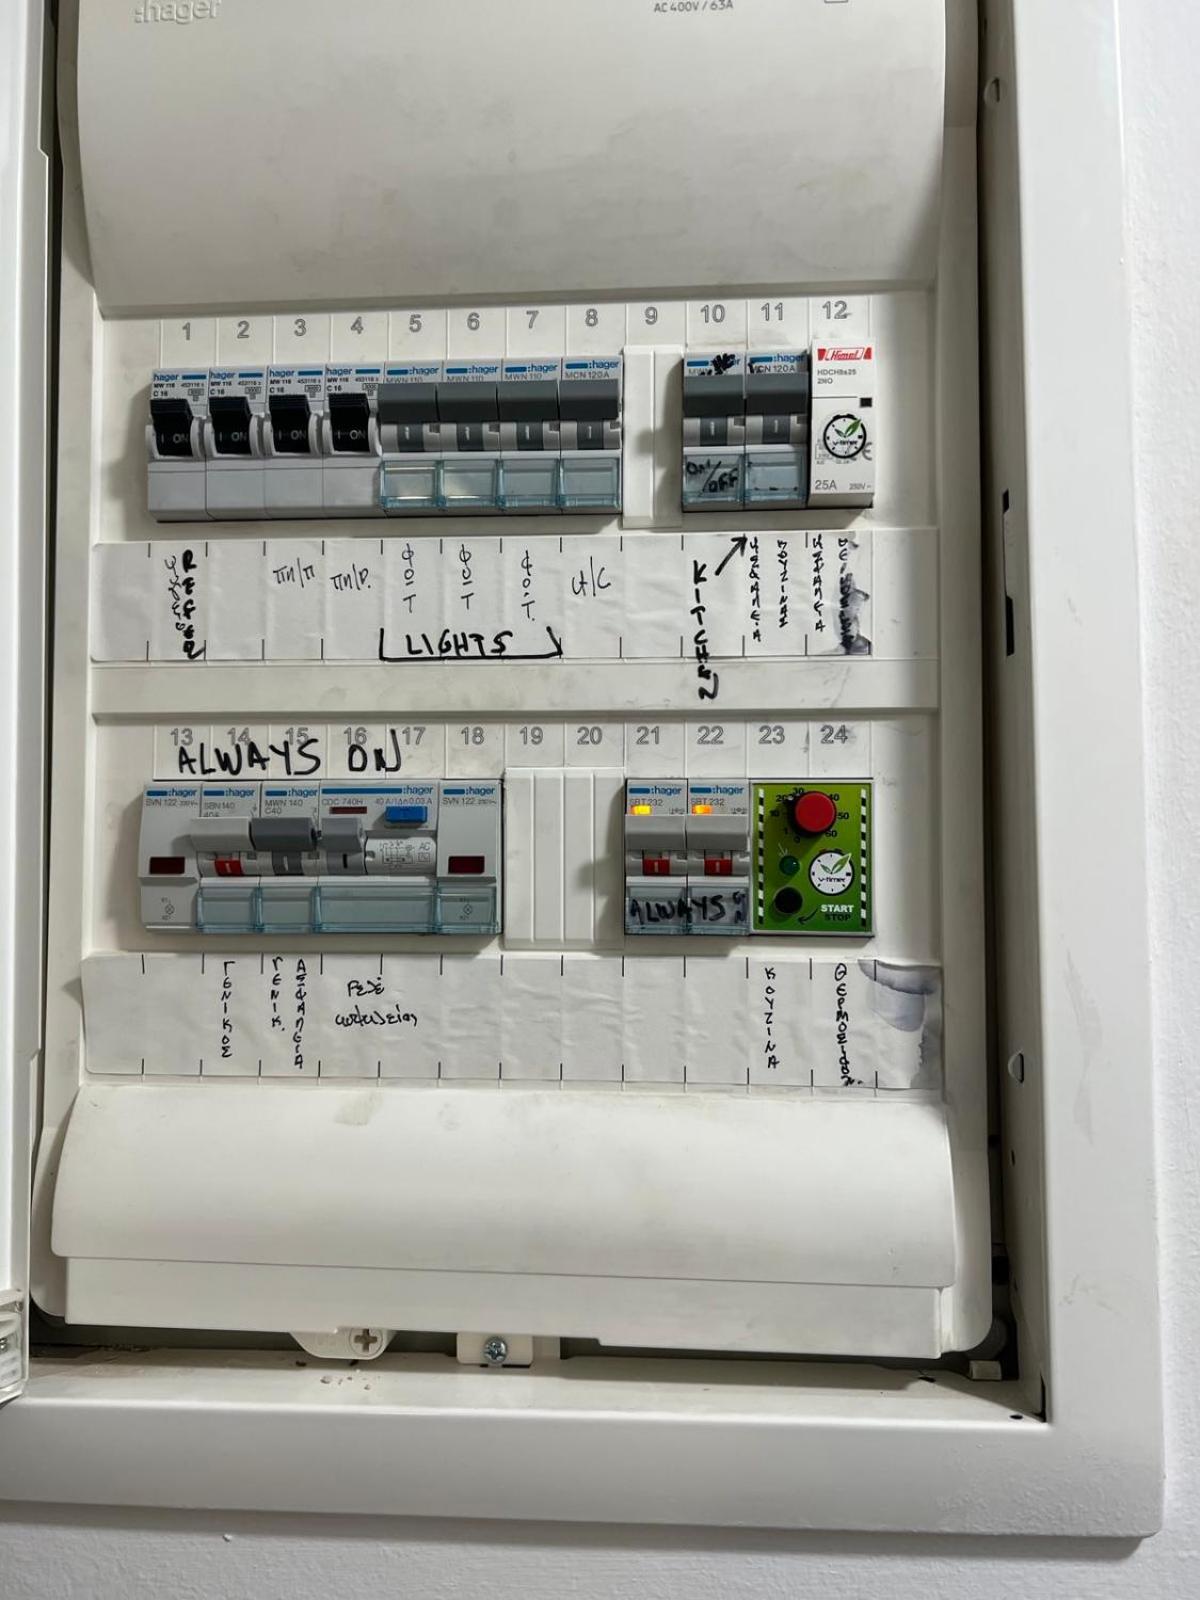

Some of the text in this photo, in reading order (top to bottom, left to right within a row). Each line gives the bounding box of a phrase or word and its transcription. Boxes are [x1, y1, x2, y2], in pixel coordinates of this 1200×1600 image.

[654, 2, 668, 13] AC
[670, 1, 699, 12] 400V
[710, 0, 734, 11] 63A
[526, 310, 539, 329] 7
[585, 308, 598, 327] 8
[644, 306, 658, 325] 9
[700, 304, 725, 323] 10
[761, 302, 784, 321] 11
[822, 301, 849, 320] 12
[182, 322, 191, 340] 1
[237, 320, 250, 339] 2
[294, 318, 307, 337] 3
[350, 316, 364, 334] 4
[409, 314, 422, 333] 5
[467, 312, 480, 331] 6
[773, 364, 796, 373] 120A
[173, 432, 189, 443] ON
[232, 431, 247, 442] ON
[290, 429, 306, 440] ON
[350, 429, 366, 440] ON
[815, 480, 837, 490] 25A
[405, 628, 513, 656] LIGHTS
[170, 728, 193, 746] 13
[227, 727, 250, 746] 14
[285, 727, 309, 746] 15
[343, 726, 367, 745] 16
[402, 726, 426, 745] 17
[461, 726, 484, 745] 18
[520, 726, 543, 745] 19
[577, 726, 603, 745] 20
[636, 726, 660, 745] 21
[697, 726, 724, 745] 22
[758, 726, 785, 745] 23
[820, 725, 848, 744] 24
[179, 729, 400, 776] ALWAYS ON
[630, 895, 726, 926] ALWAYS
[821, 904, 854, 913] START
[825, 913, 851, 921] STOP
